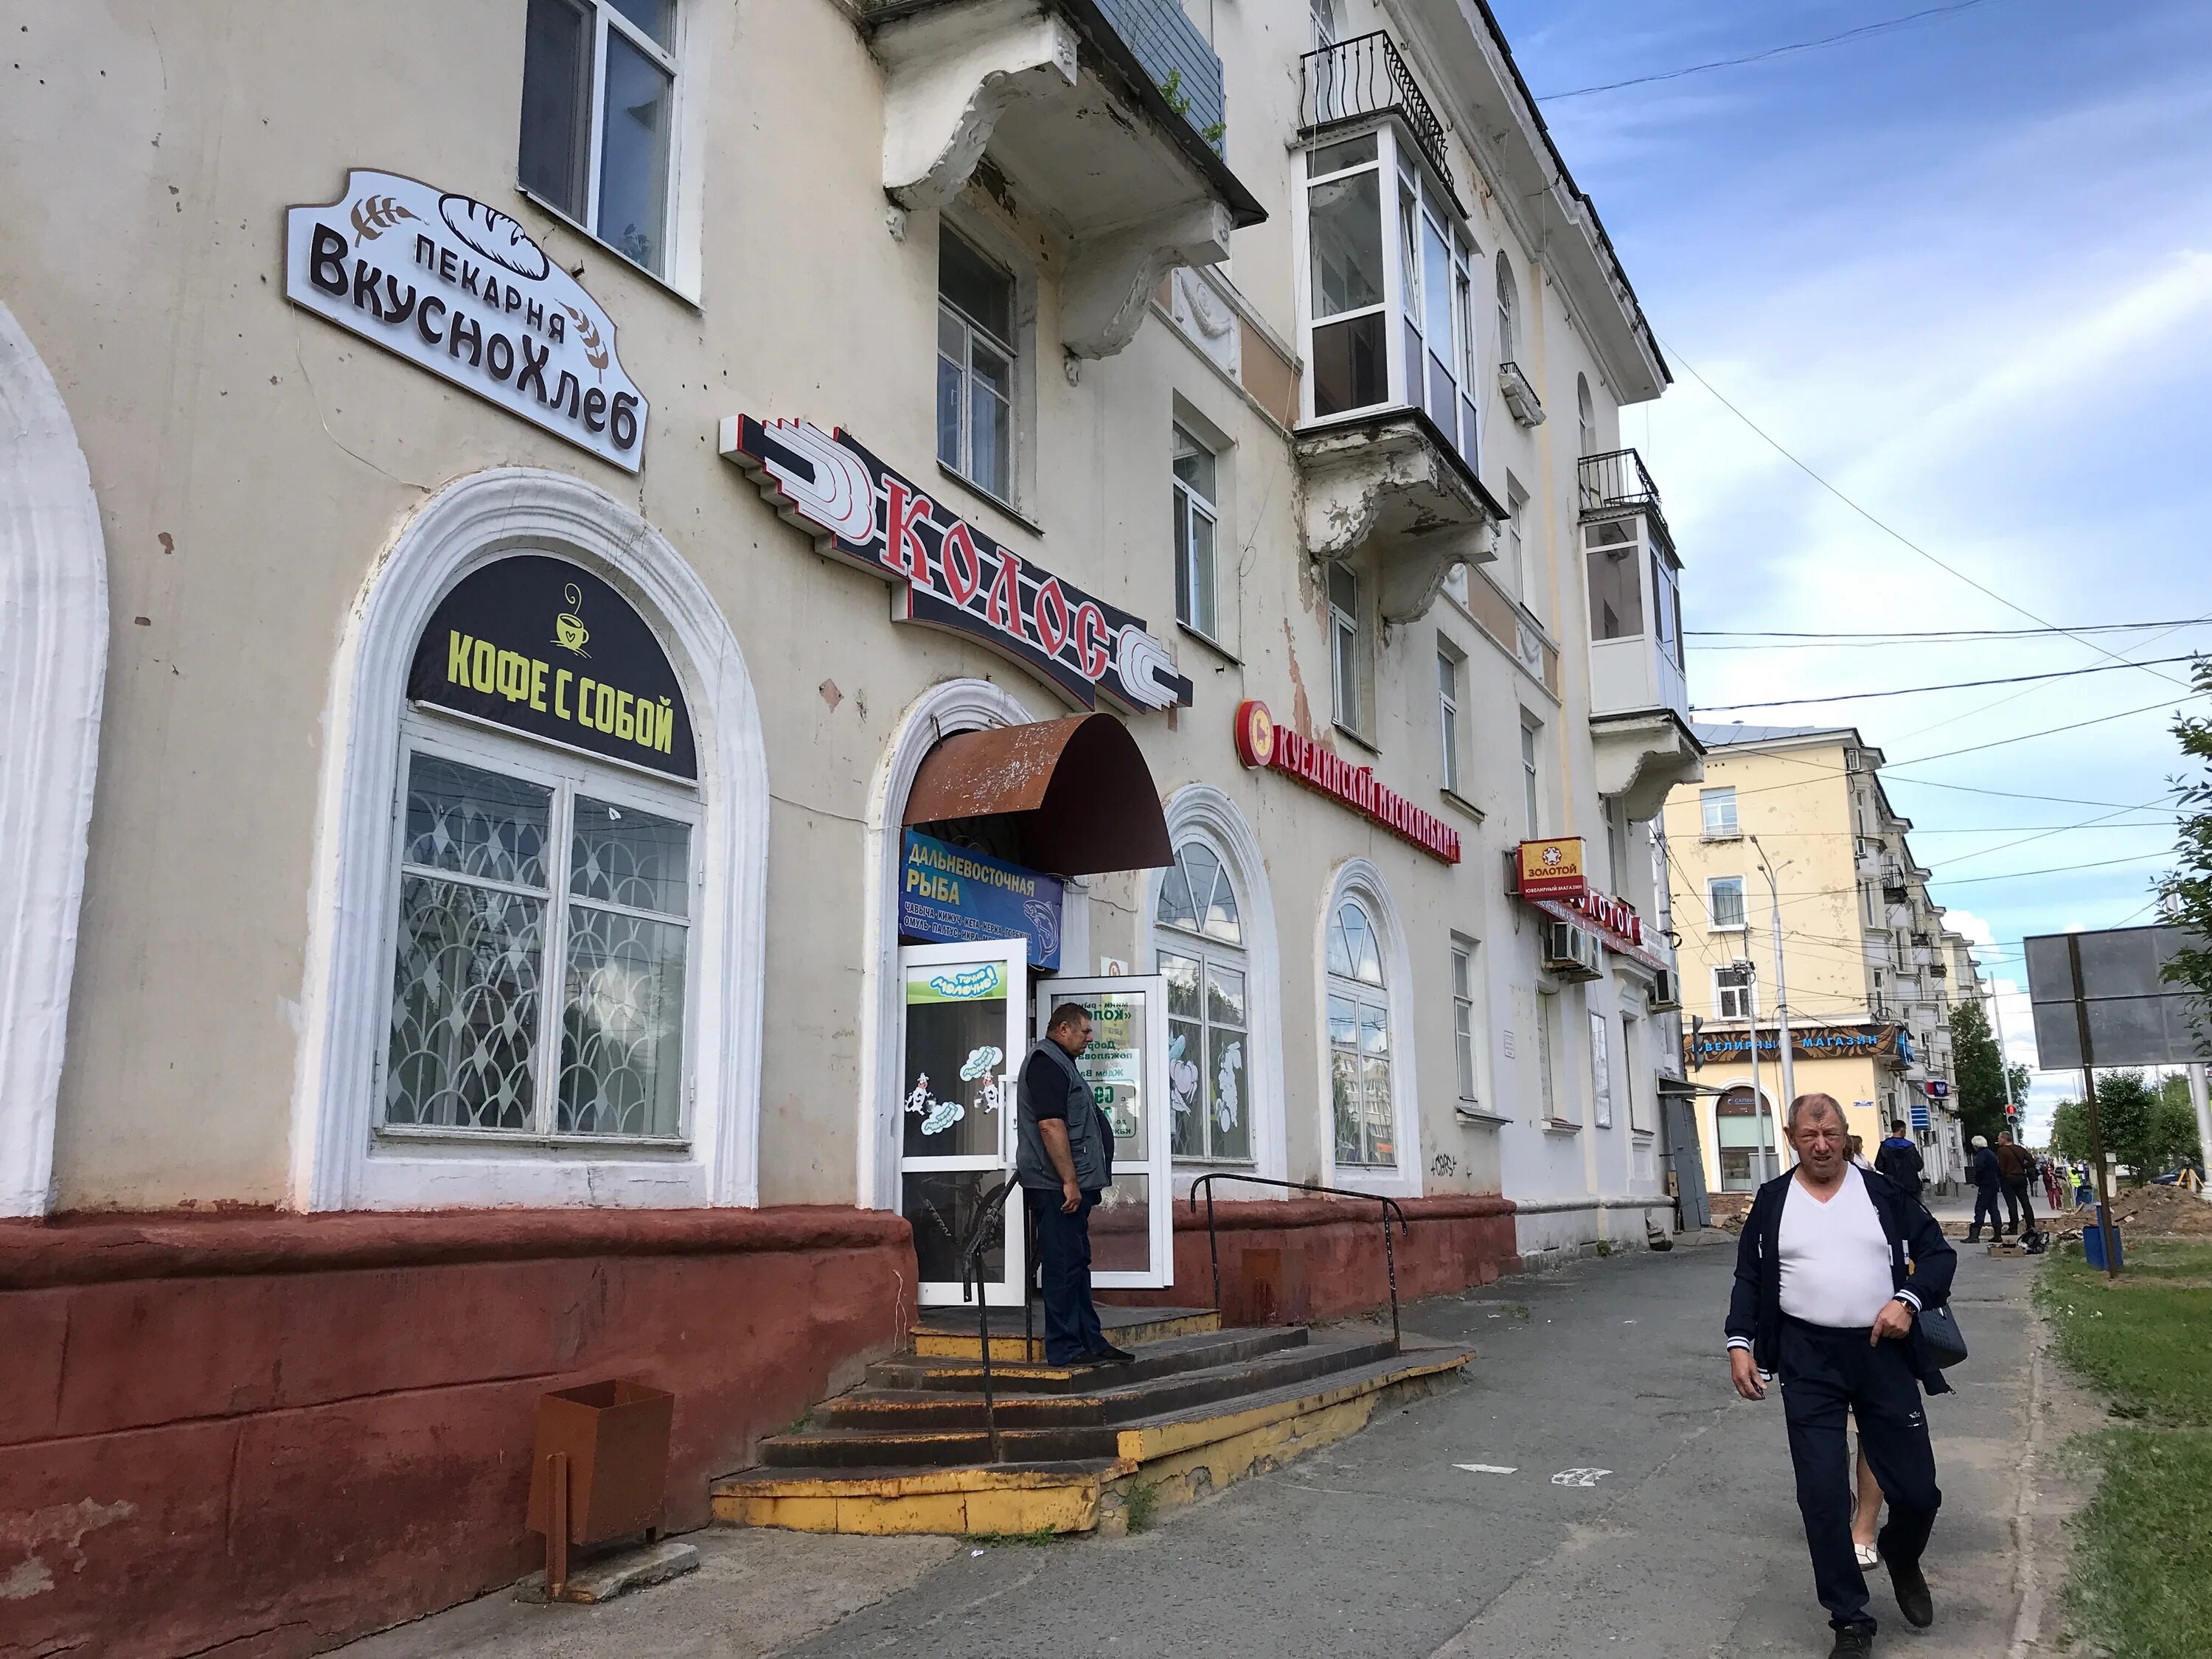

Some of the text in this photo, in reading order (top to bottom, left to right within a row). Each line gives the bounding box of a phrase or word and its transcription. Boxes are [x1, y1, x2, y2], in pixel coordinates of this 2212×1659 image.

[415, 233, 566, 344] ПЕКАРНЯ
[880, 475, 1110, 679] КОЛОС
[448, 629, 674, 754] КОФЕ С СОБОЙ
[1279, 725, 1376, 813] КУЕДИНСКИЙ
[1379, 782, 1461, 863] МЯСОКОМБИНАТ
[906, 869, 960, 905] РЫБА
[908, 844, 1035, 897] ДАЛЬНЕВОСТОЧНАЯ
[1525, 885, 1557, 894] ЮВЕЛИРНЫЙ
[1528, 863, 1577, 877] ЗОЛОТОЙ
[903, 916, 979, 941] ОМУЛЬ ПАЛТУС ИКРА
[905, 901, 934, 919] ЧАВЫЧА
[937, 911, 961, 925] КИЖУЧ
[964, 917, 979, 929] КЕТА
[983, 922, 1003, 936] НЕРКА
[1570, 889, 1632, 938] ЛОТОЙ
[1691, 1035, 1877, 1052] ВЕЛИРНЫ МАГАЗИН
